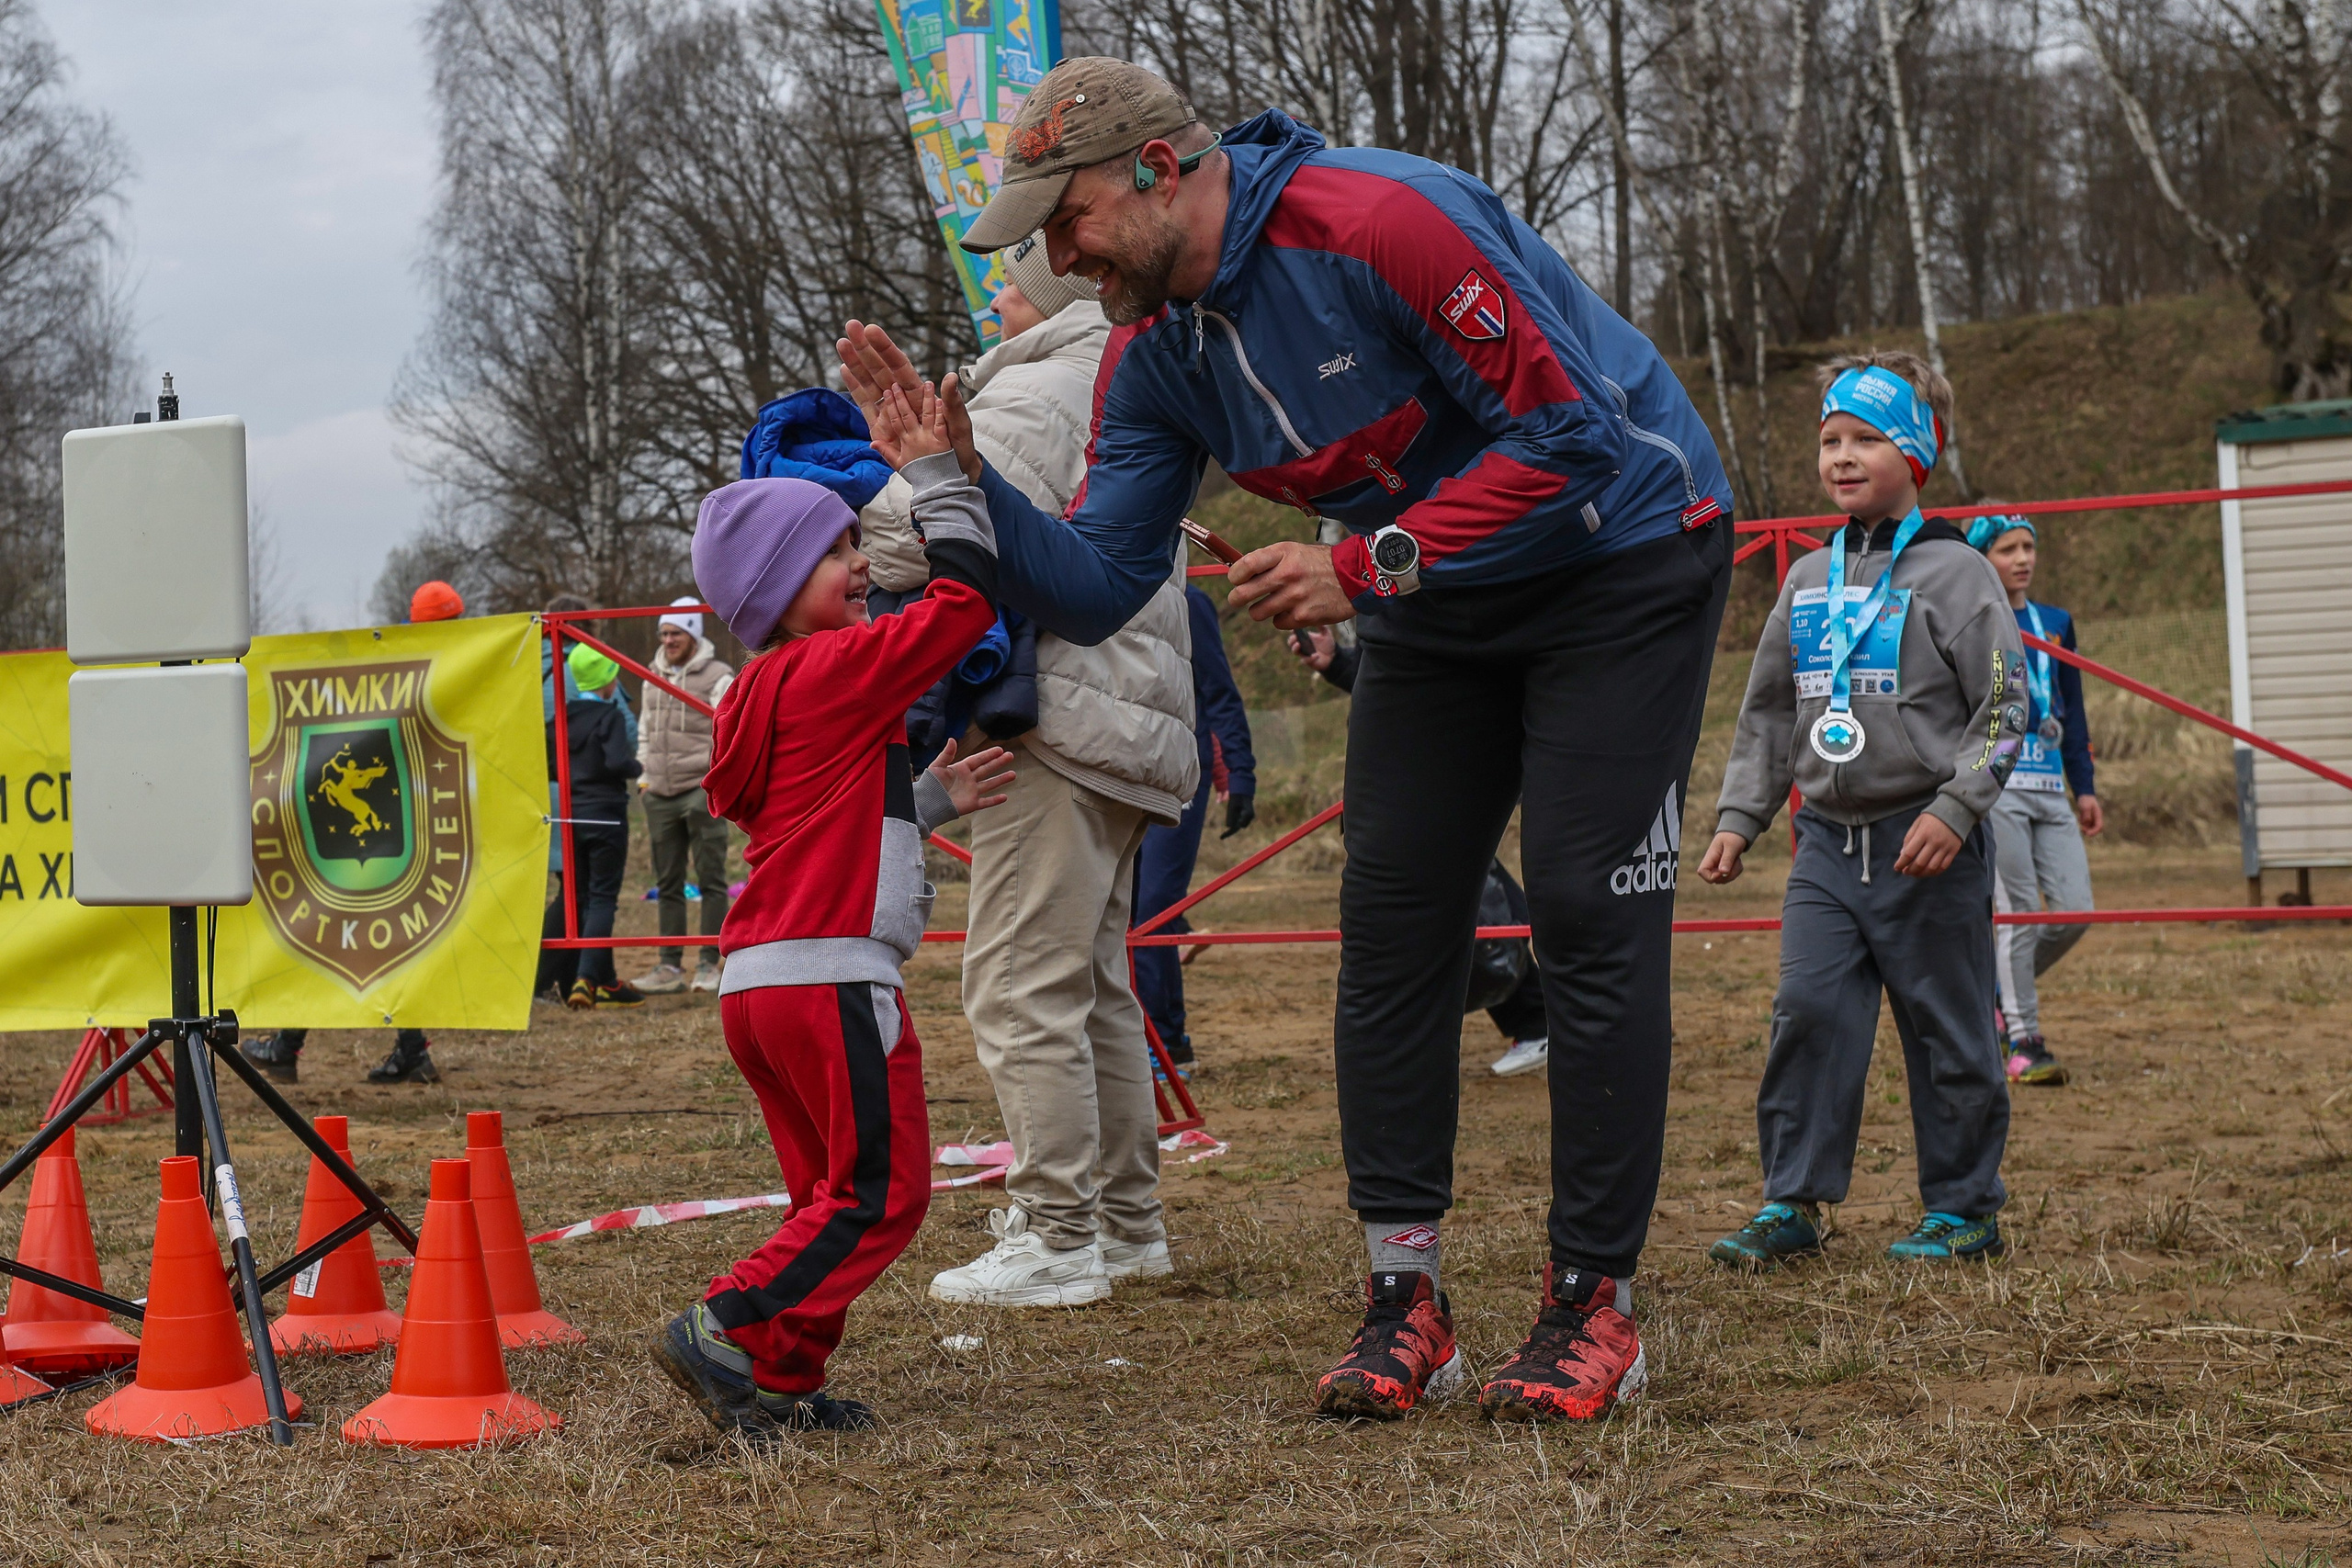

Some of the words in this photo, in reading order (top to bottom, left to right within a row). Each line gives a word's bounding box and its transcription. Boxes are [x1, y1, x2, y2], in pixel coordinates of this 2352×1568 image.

[1854, 382, 1893, 406] РОССИИ
[1808, 654, 1833, 664] Соколо
[1992, 649, 2004, 705] ENJOY
[283, 670, 414, 719] ХИМКИ
[1989, 709, 2001, 739] THE
[251, 787, 460, 950] СПОРТКОМИТЕТ
[1610, 851, 1678, 895] adid
